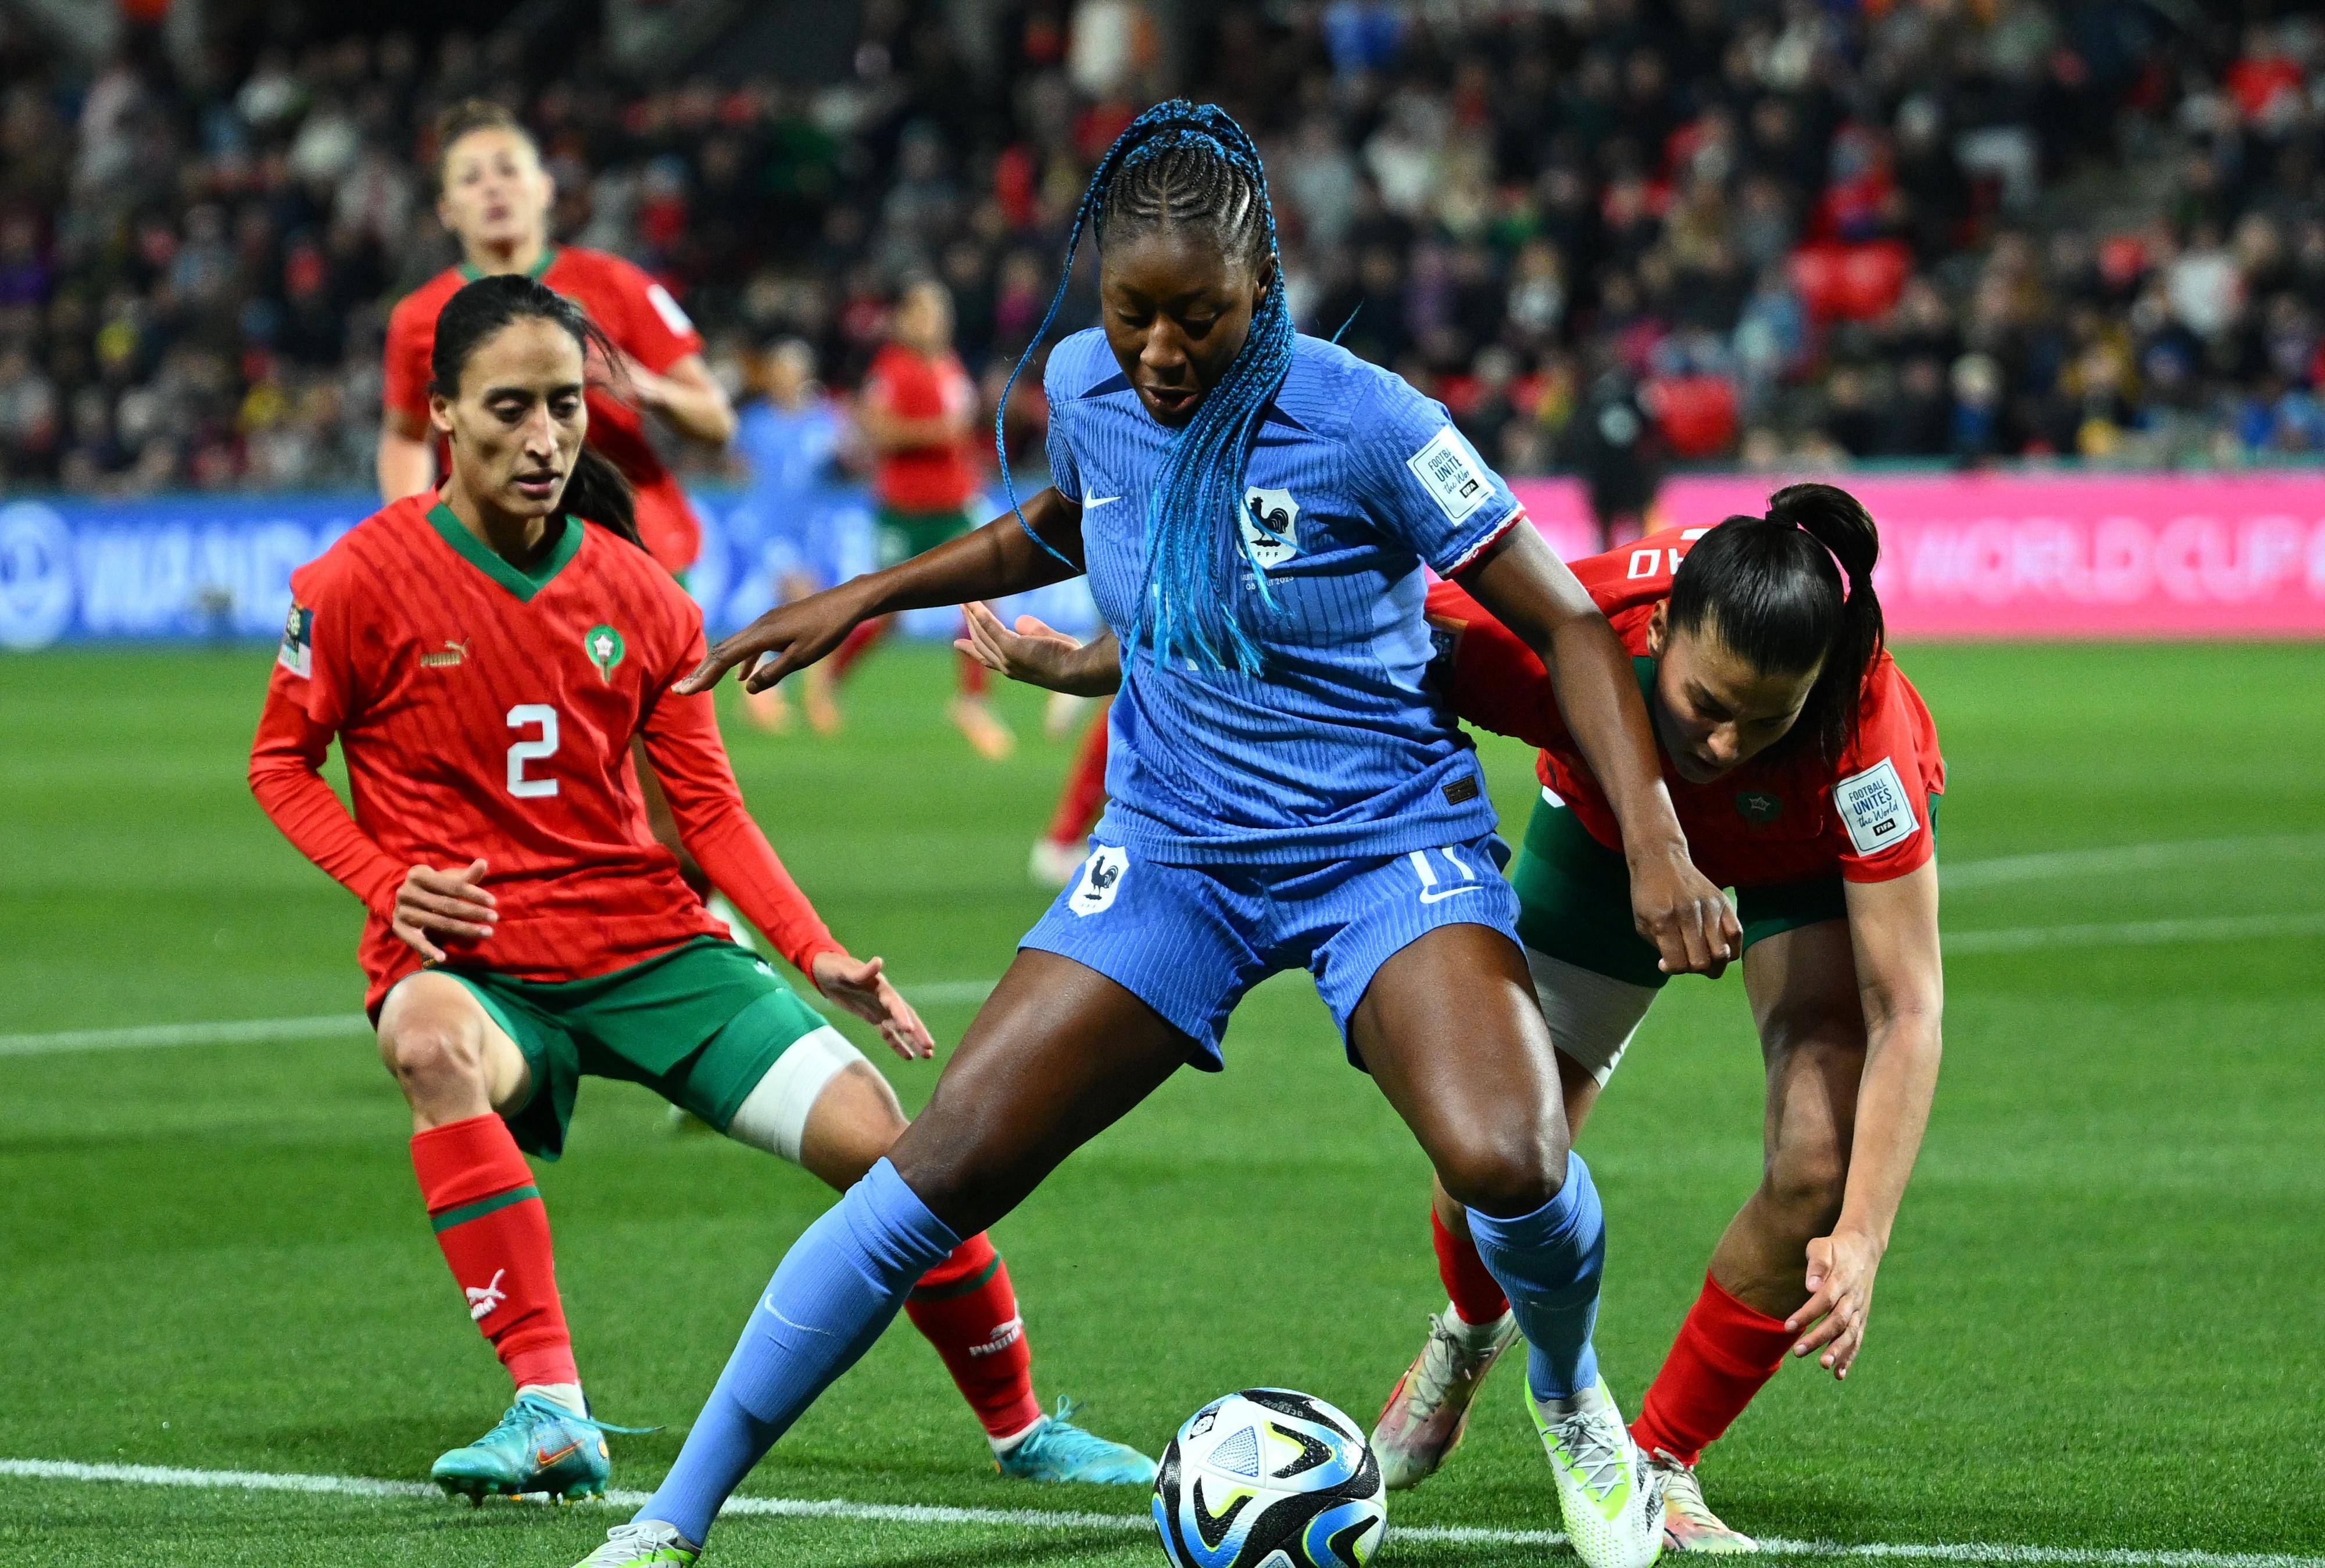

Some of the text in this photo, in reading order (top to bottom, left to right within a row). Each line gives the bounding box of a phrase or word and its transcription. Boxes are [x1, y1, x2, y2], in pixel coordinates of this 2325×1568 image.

[1435, 456, 1462, 482] UNITE
[1454, 470, 1470, 484] Wor
[507, 704, 559, 798] 2
[1848, 779, 1886, 802] FOOTBALL
[1852, 788, 1892, 815] UNITES
[1856, 800, 1899, 828] the World
[1876, 821, 1894, 834] FIFA
